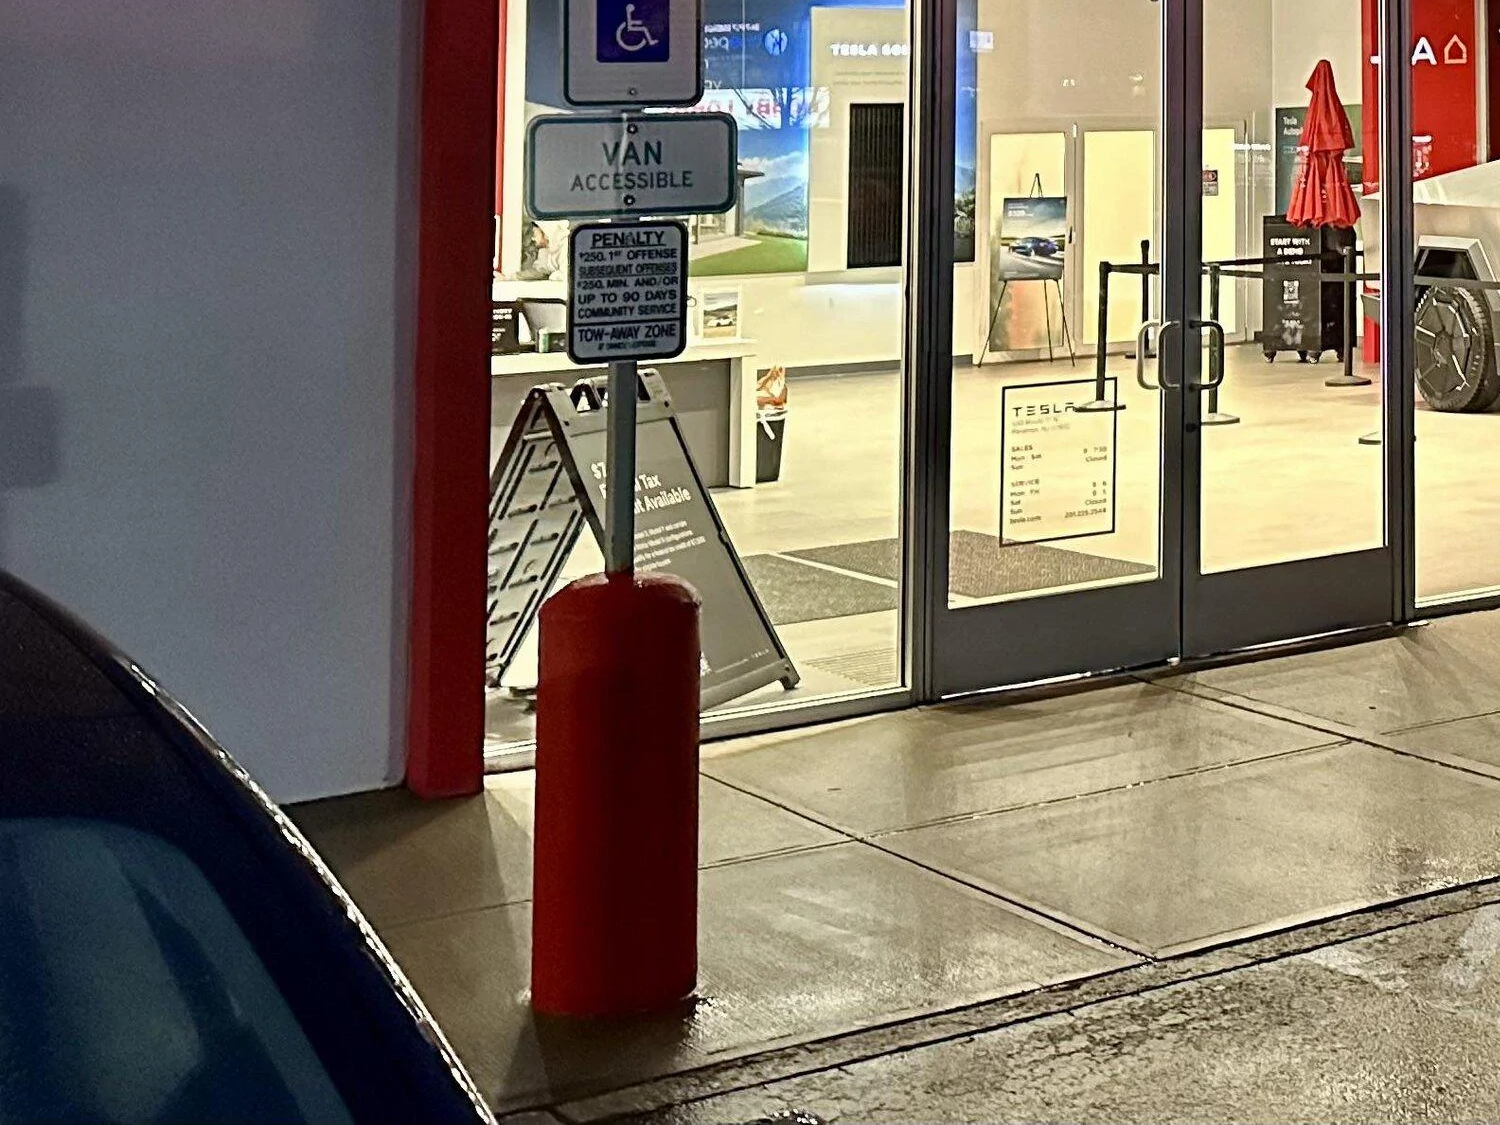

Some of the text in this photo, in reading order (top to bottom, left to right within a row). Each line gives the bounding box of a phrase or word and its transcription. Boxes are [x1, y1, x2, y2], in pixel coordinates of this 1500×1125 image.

[602, 140, 663, 167] VAN
[570, 170, 694, 192] ACCESSIBLE
[591, 230, 666, 248] PENALTY
[626, 248, 678, 261] OFFENSE
[577, 289, 678, 305] UP TO 90 DAYS
[577, 303, 677, 319] COMMUNITY SERVICE
[577, 323, 677, 342] TOW-AWAY ZONE
[1011, 401, 1075, 418] TESLA
[638, 473, 662, 490] Tax
[643, 486, 692, 512] Available
